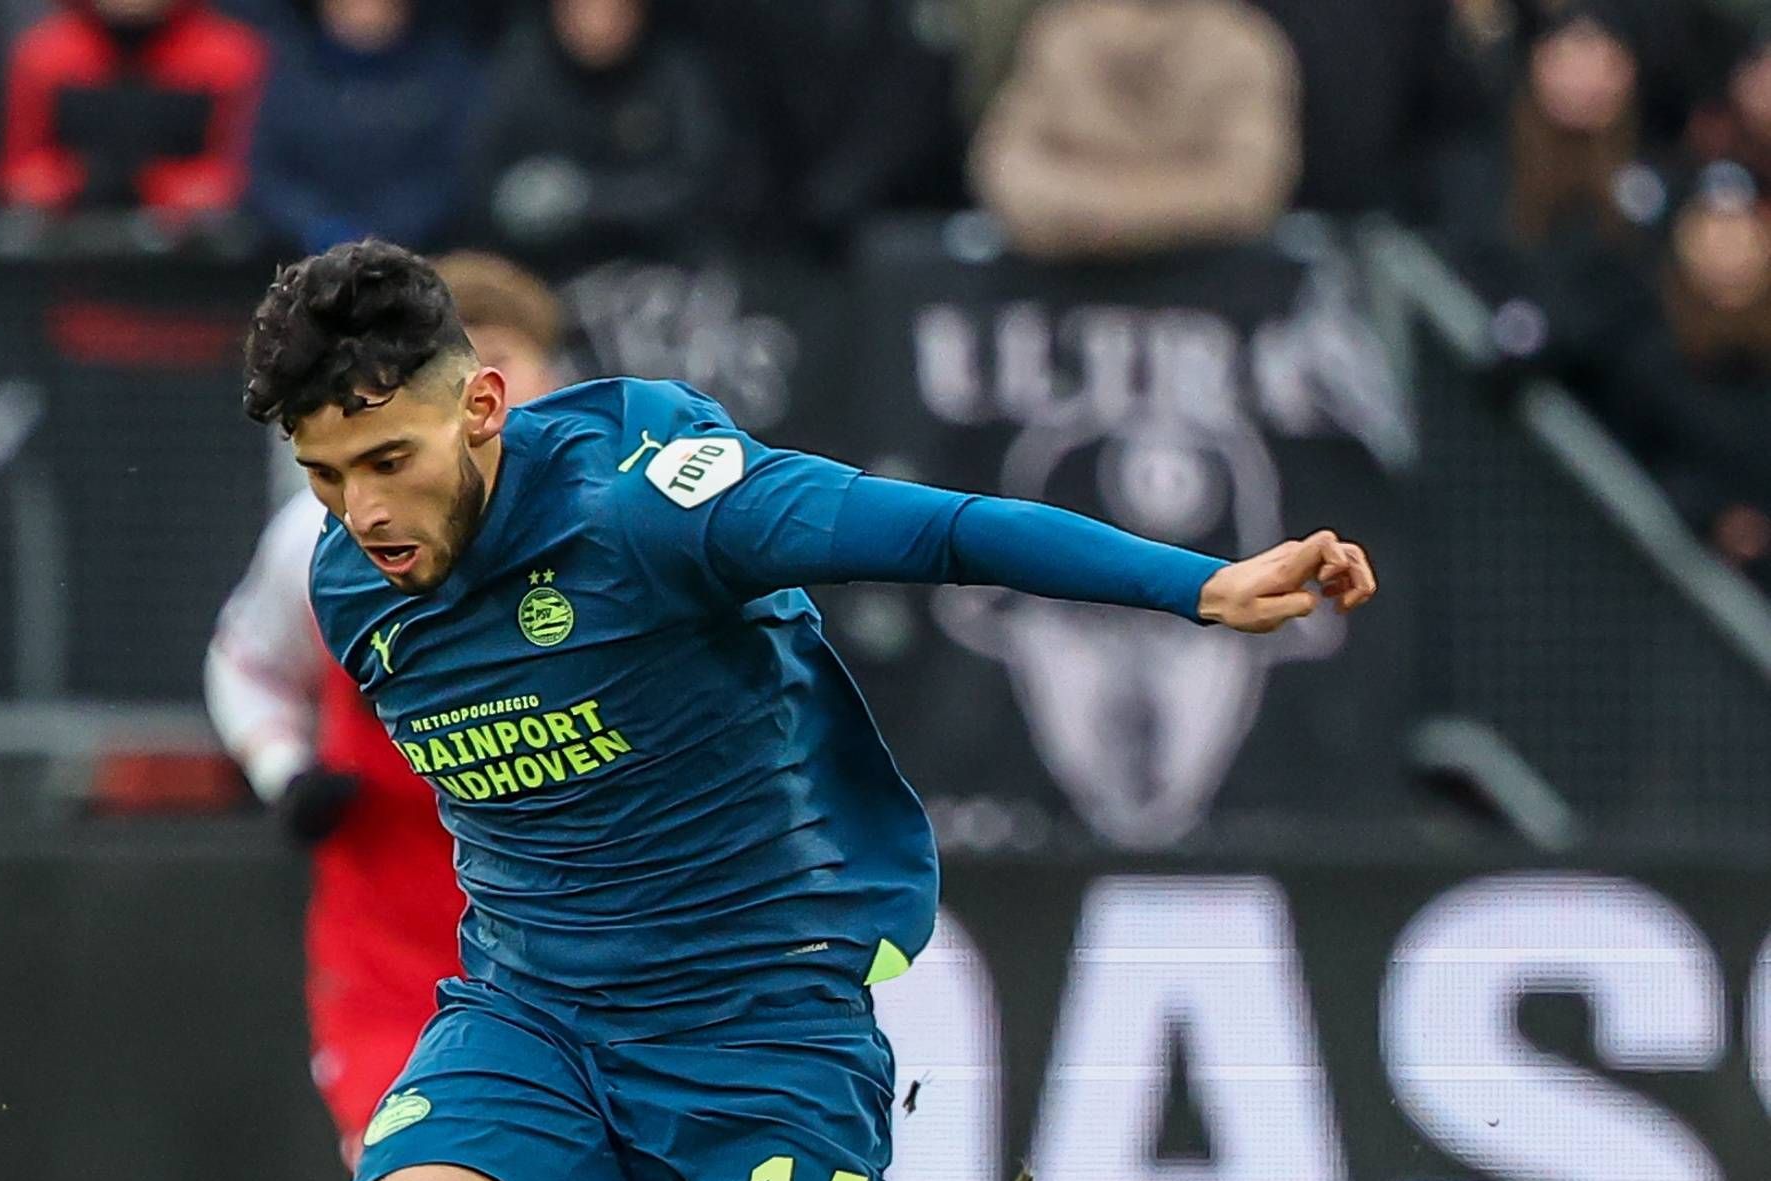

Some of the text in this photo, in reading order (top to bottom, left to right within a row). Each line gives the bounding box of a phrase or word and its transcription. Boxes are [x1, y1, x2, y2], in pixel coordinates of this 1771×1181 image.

[668, 444, 725, 493] TOTO
[535, 607, 552, 621] PSV
[410, 695, 539, 733] METROPOOLREGIO
[392, 700, 603, 774] RAINPORT
